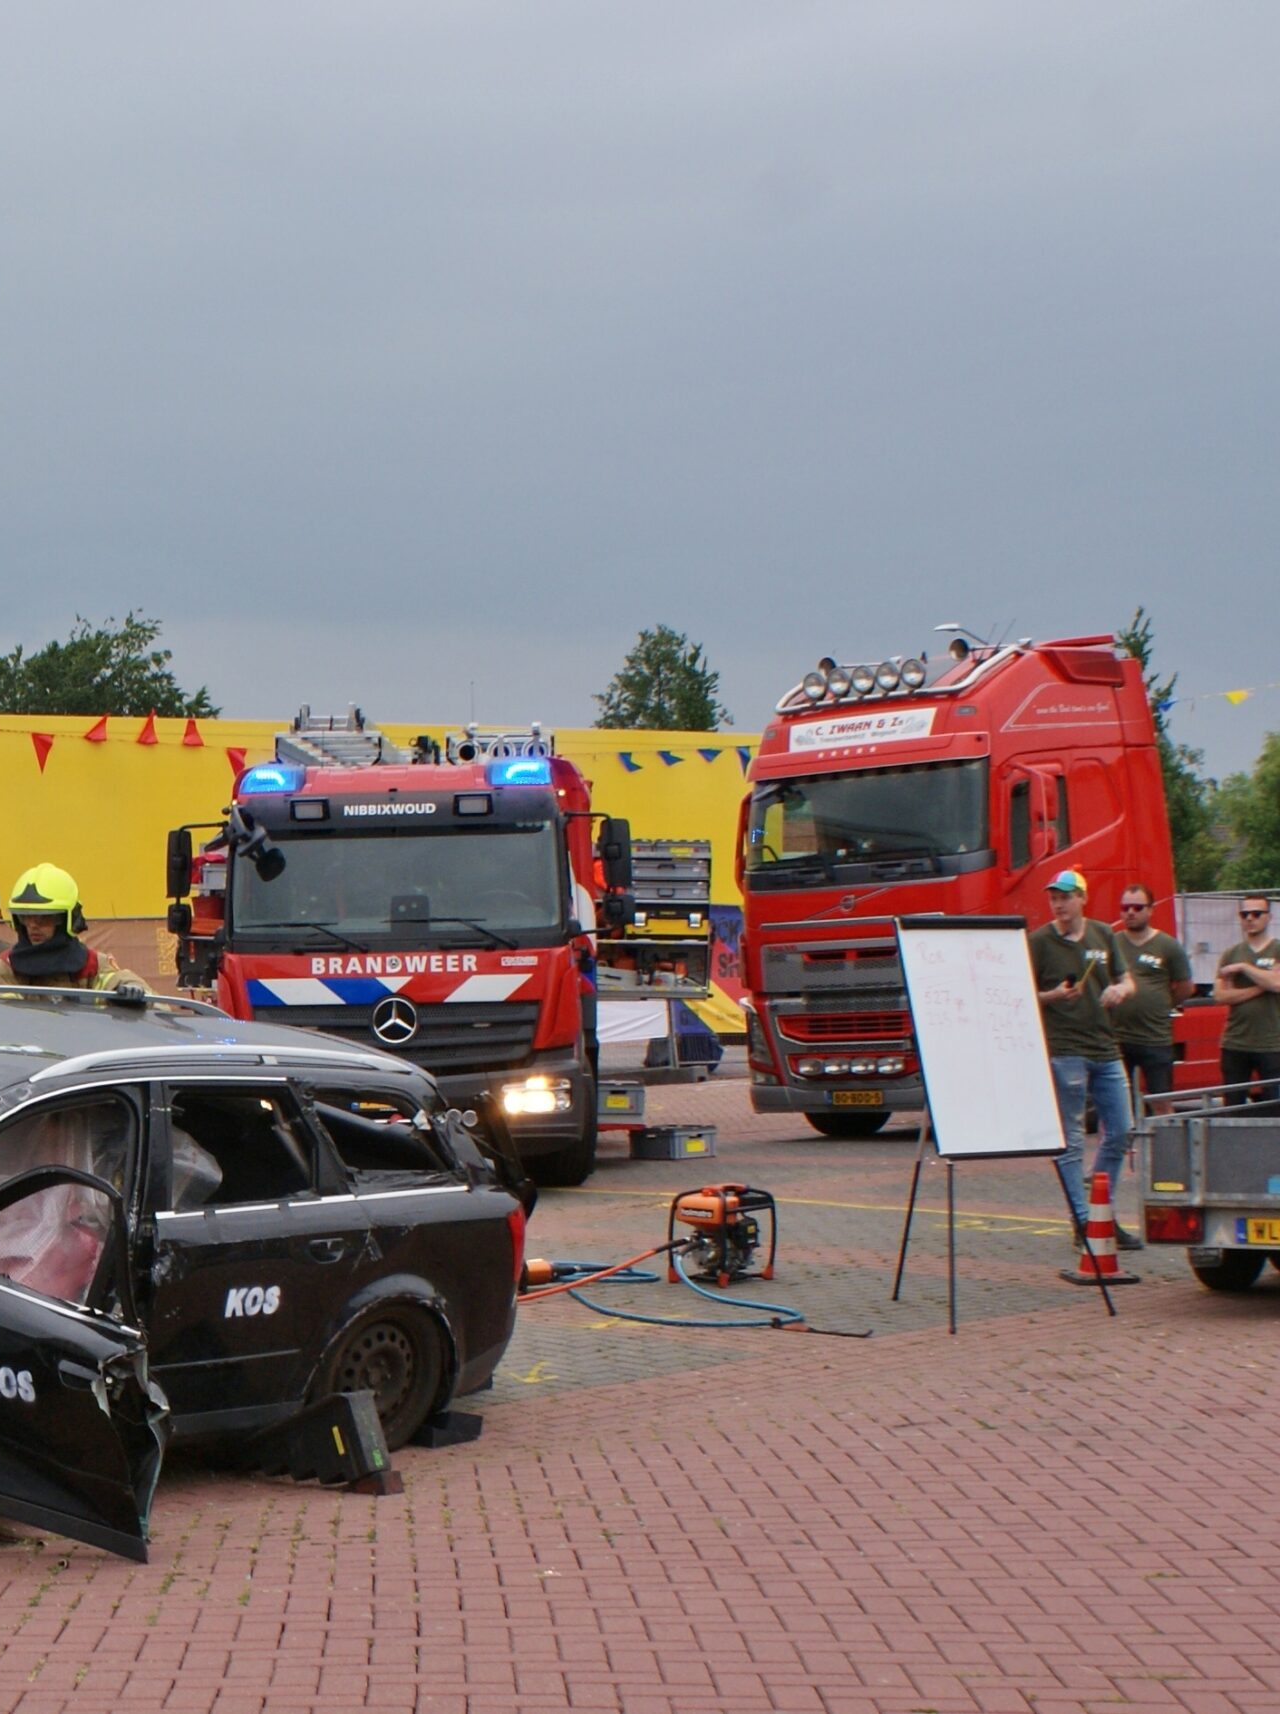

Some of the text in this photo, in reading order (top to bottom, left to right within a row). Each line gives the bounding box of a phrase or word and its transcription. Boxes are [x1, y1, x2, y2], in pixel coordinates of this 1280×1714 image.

[344, 802, 436, 817] NIBBIXWOUD
[311, 953, 478, 975] BRANDWEER
[224, 1285, 281, 1319] KOS
